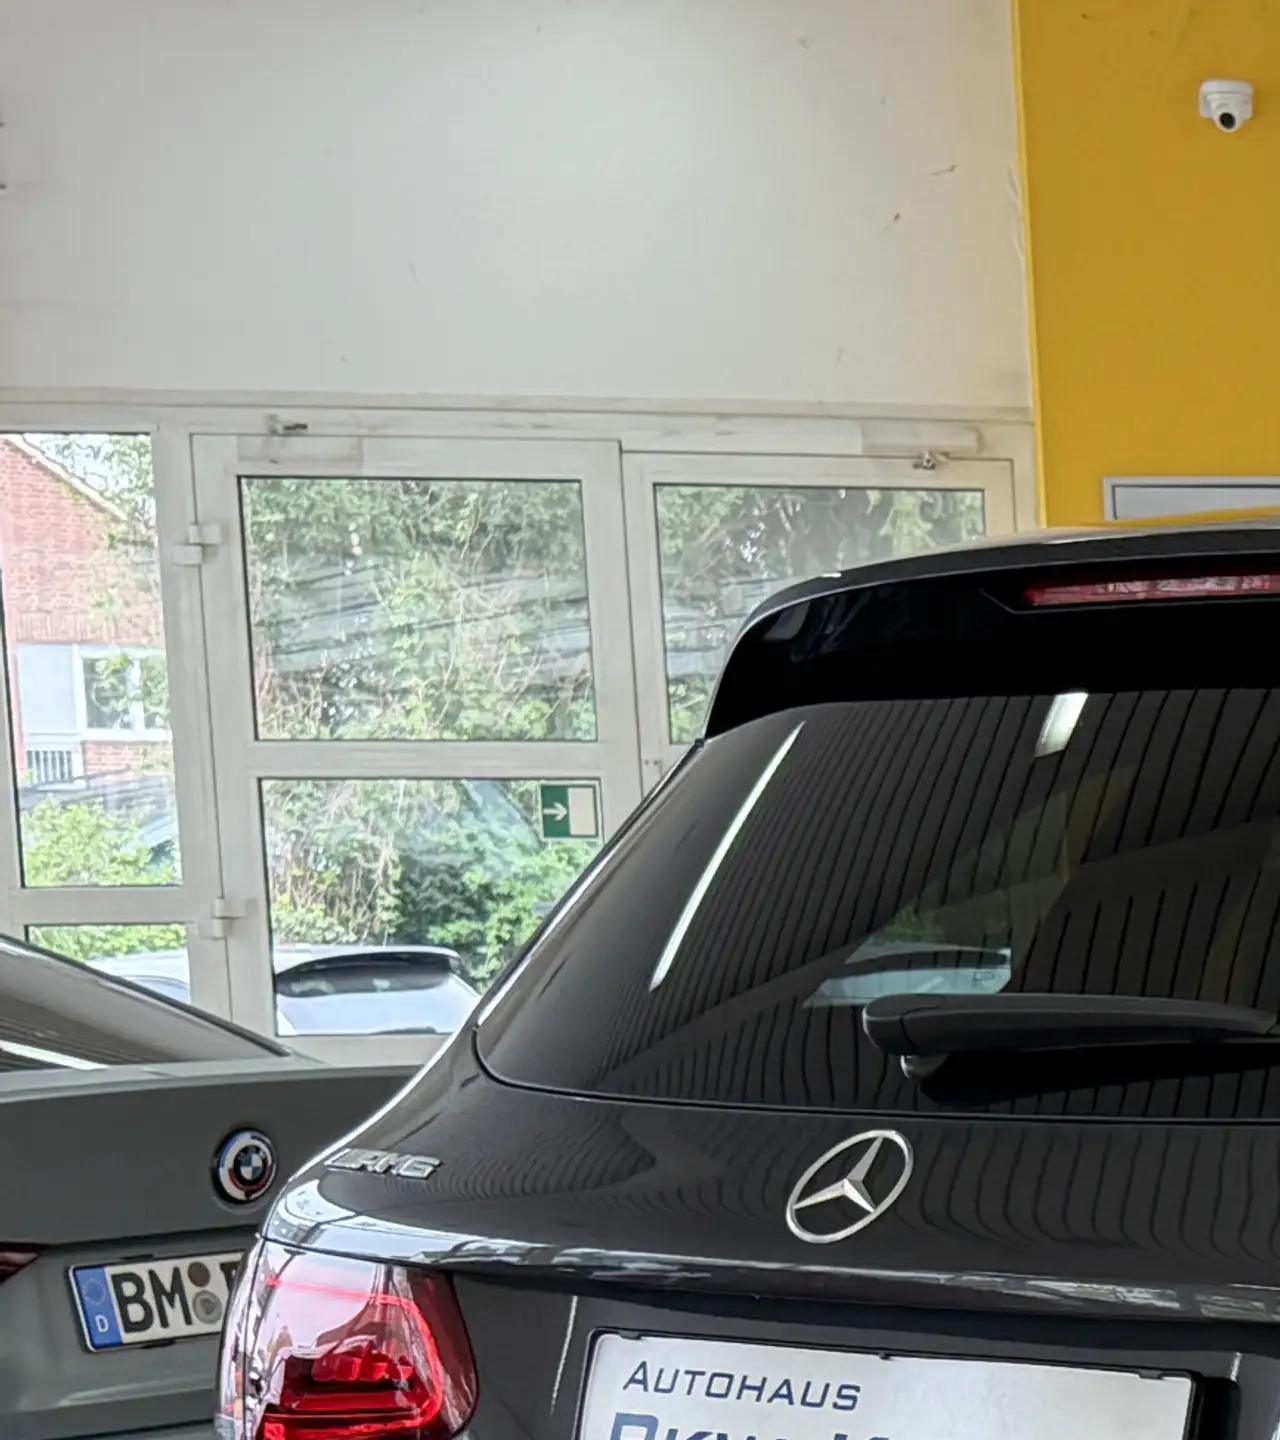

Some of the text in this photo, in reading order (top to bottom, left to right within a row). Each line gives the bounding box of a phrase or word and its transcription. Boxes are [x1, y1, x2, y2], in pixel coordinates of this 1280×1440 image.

[95, 1316, 109, 1333] D
[110, 1266, 193, 1334] BM
[622, 1360, 861, 1411] AUTOHAUS
